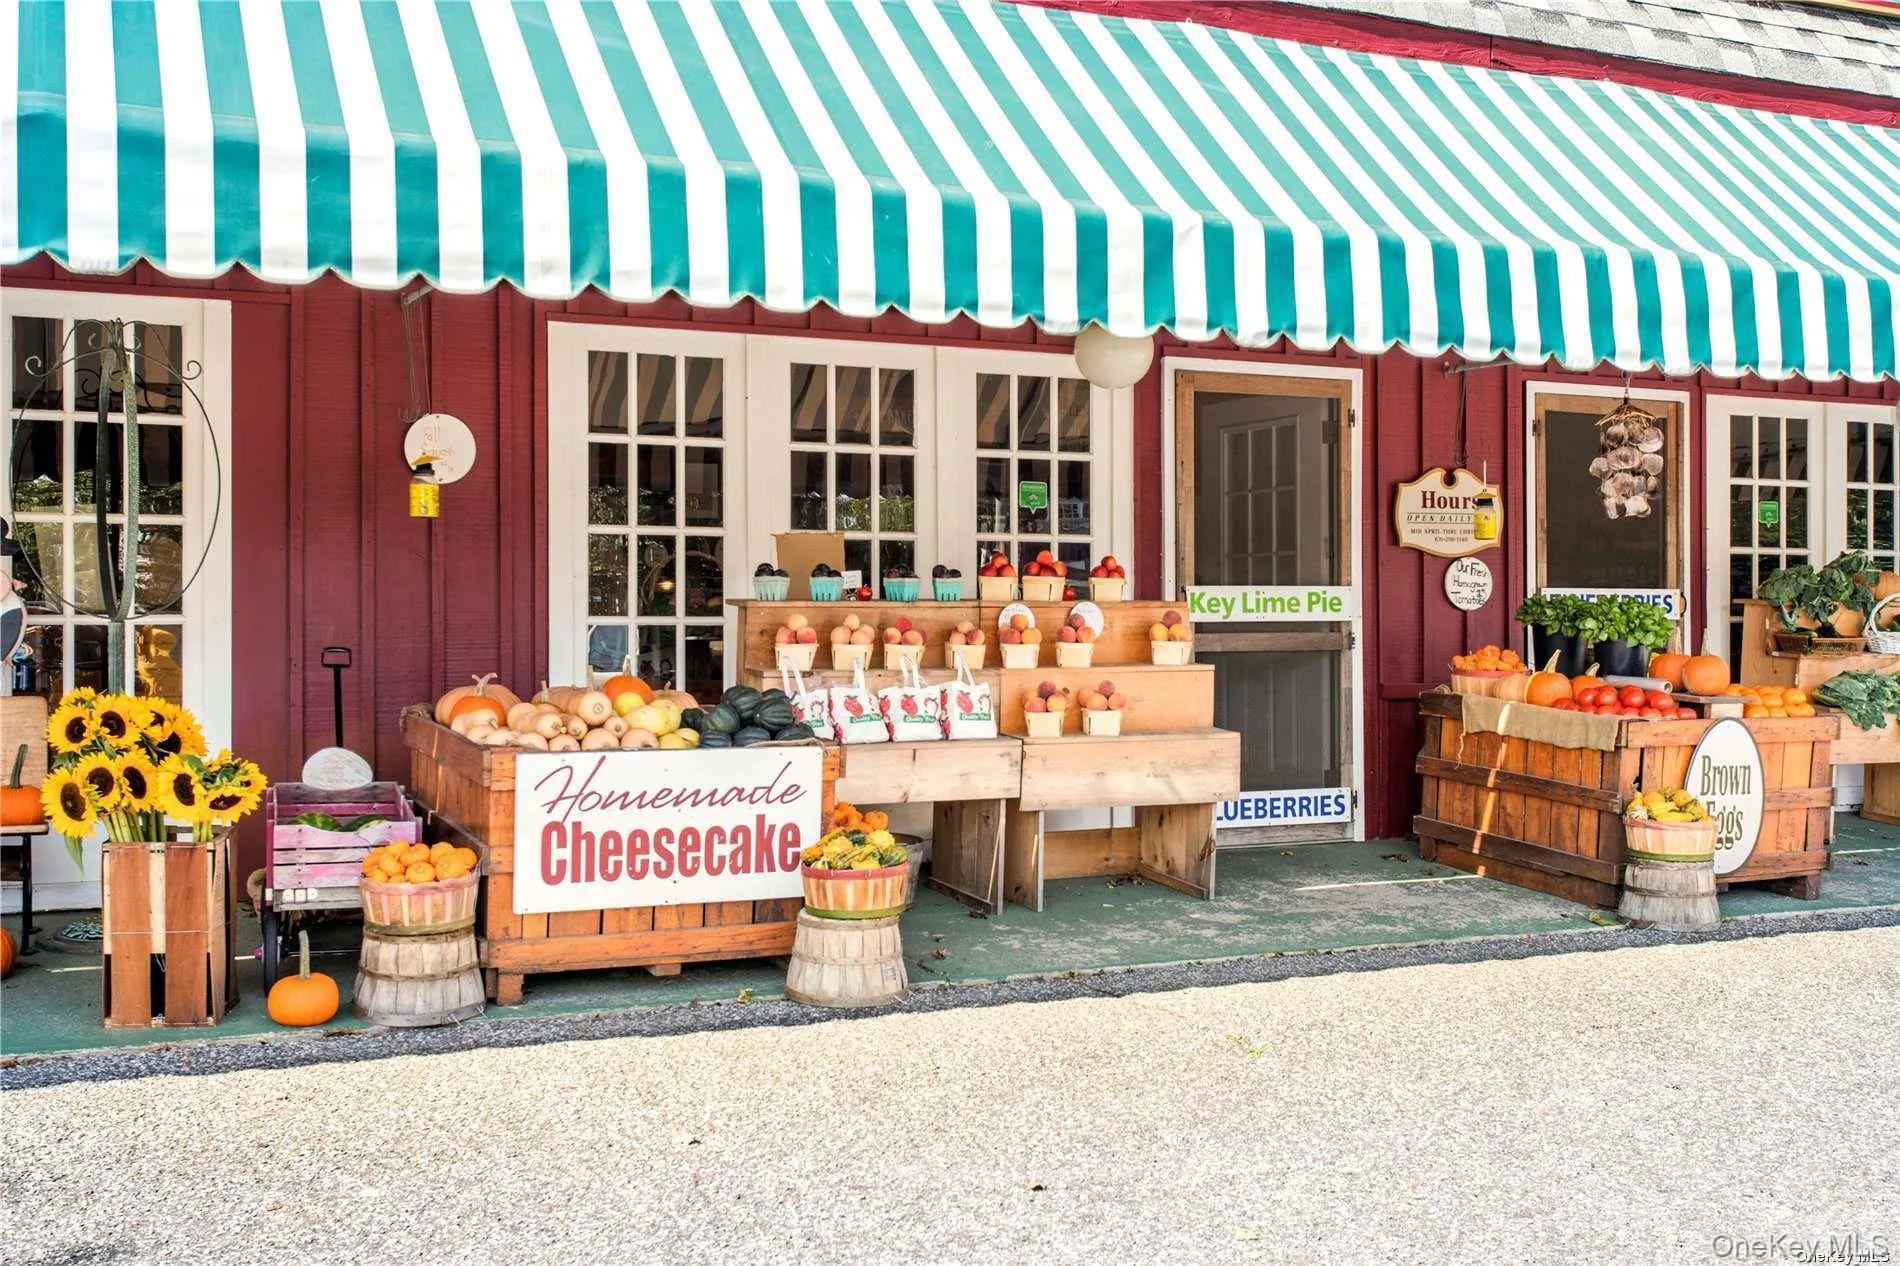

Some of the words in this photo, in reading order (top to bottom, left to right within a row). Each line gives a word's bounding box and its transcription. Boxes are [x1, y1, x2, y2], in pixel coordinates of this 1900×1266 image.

[1440, 514, 1472, 522] DAILY
[1190, 591, 1235, 619] Key
[1242, 590, 1300, 613] Lime
[1307, 590, 1342, 613] Pie
[534, 755, 808, 824] Homemade
[1700, 755, 1751, 796] Brown
[1216, 794, 1346, 821] UEBERRIES
[541, 814, 801, 886] Cheesecake
